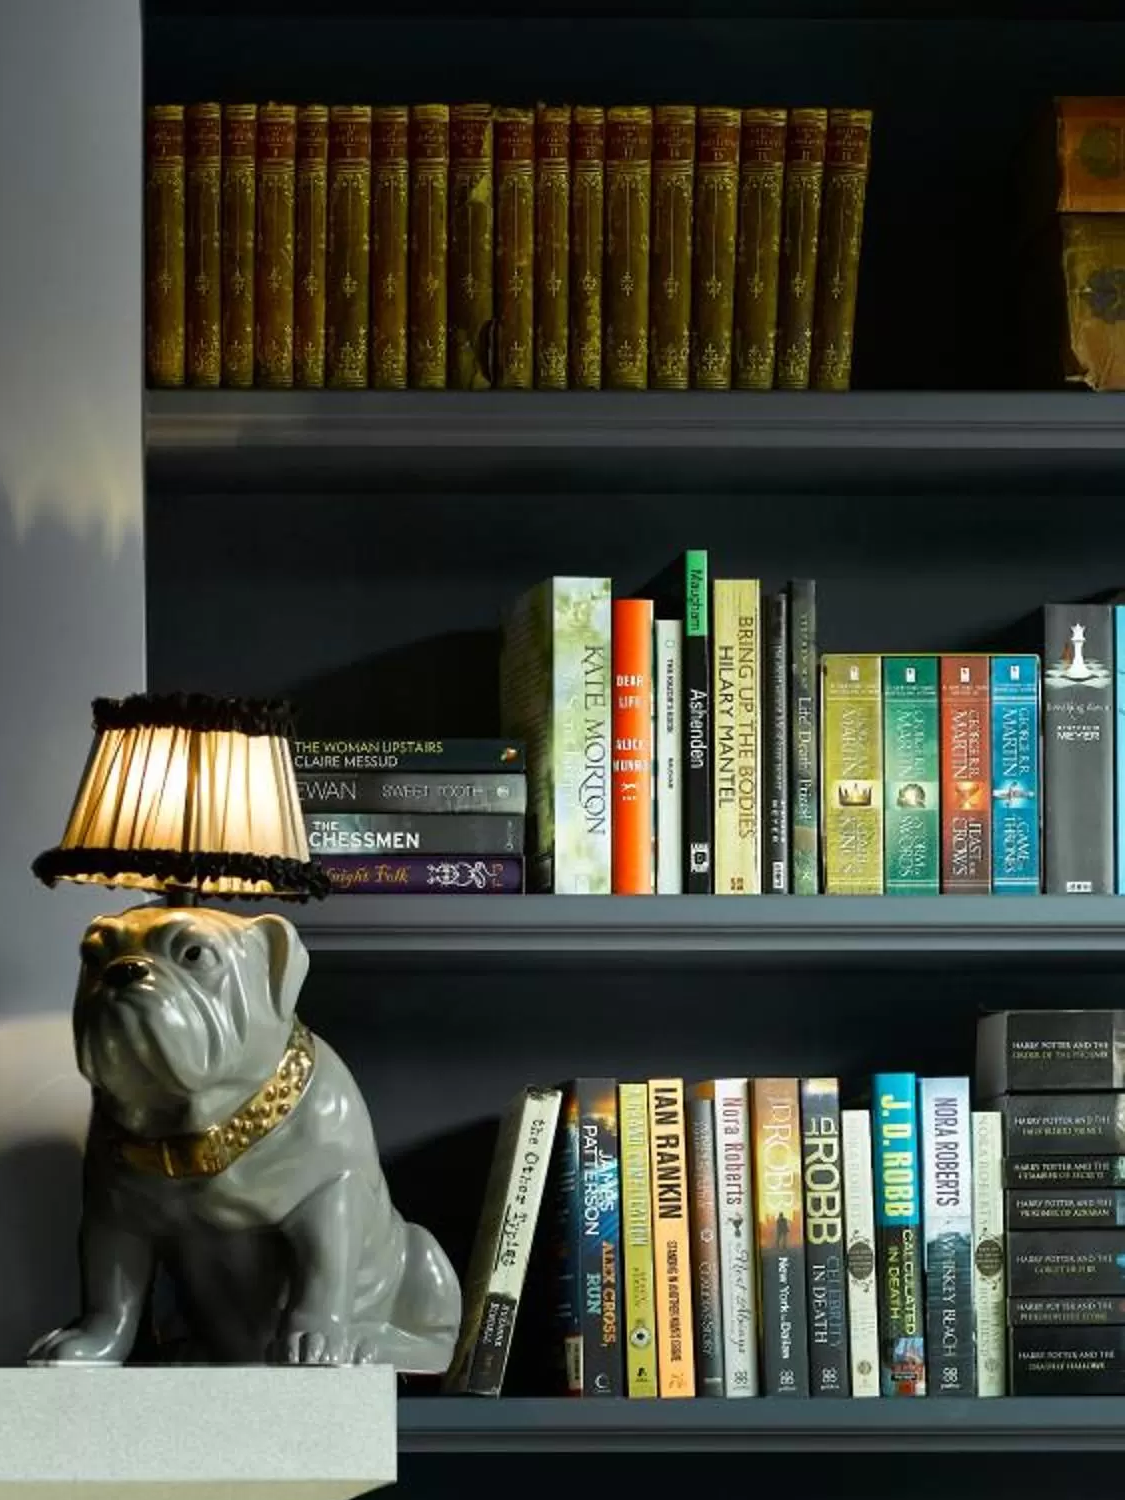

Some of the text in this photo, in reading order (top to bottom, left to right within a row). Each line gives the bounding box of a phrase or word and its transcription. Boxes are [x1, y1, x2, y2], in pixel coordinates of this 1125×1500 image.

[690, 569, 705, 631] Maugham
[616, 675, 644, 687] DEAR
[294, 741, 444, 753] THE WOMAN UPSTAIRS
[294, 755, 399, 768] CLAIRE MESSUD
[579, 645, 606, 835] KATE MORTON
[690, 688, 708, 769] Ashenden
[719, 645, 735, 808] HILARY MANTEL
[739, 617, 755, 839] BRING UP THE BODIES
[897, 709, 913, 778] MARTIN
[952, 710, 968, 780] MARTIN
[1002, 707, 1018, 777] MARTIN
[1057, 731, 1100, 741] MEYER
[308, 832, 420, 849] CHESSMEN
[312, 820, 340, 831] THE
[952, 817, 968, 876] CROWS
[583, 1124, 600, 1236] PATTERSON
[654, 1087, 683, 1220] IAN RANKIN
[722, 1097, 746, 1206] Nora Roberts
[763, 1123, 794, 1209] ROBB
[880, 1094, 915, 1218] J. D. ROBB
[934, 1097, 960, 1207] NORA ROBERTS
[499, 1118, 546, 1268] the Other Typist
[805, 1137, 842, 1245] ROBB
[586, 1273, 601, 1315] RUN
[601, 1241, 615, 1285] ALEX
[778, 1257, 788, 1284] New
[779, 1285, 790, 1313] York
[888, 1246, 900, 1320] IN DEATH
[901, 1229, 916, 1335] CALCULATED
[940, 1235, 957, 1356] WHISKEY BEACH
[812, 1264, 828, 1344] IN DEATH
[827, 1255, 842, 1349] CELEBRITY
